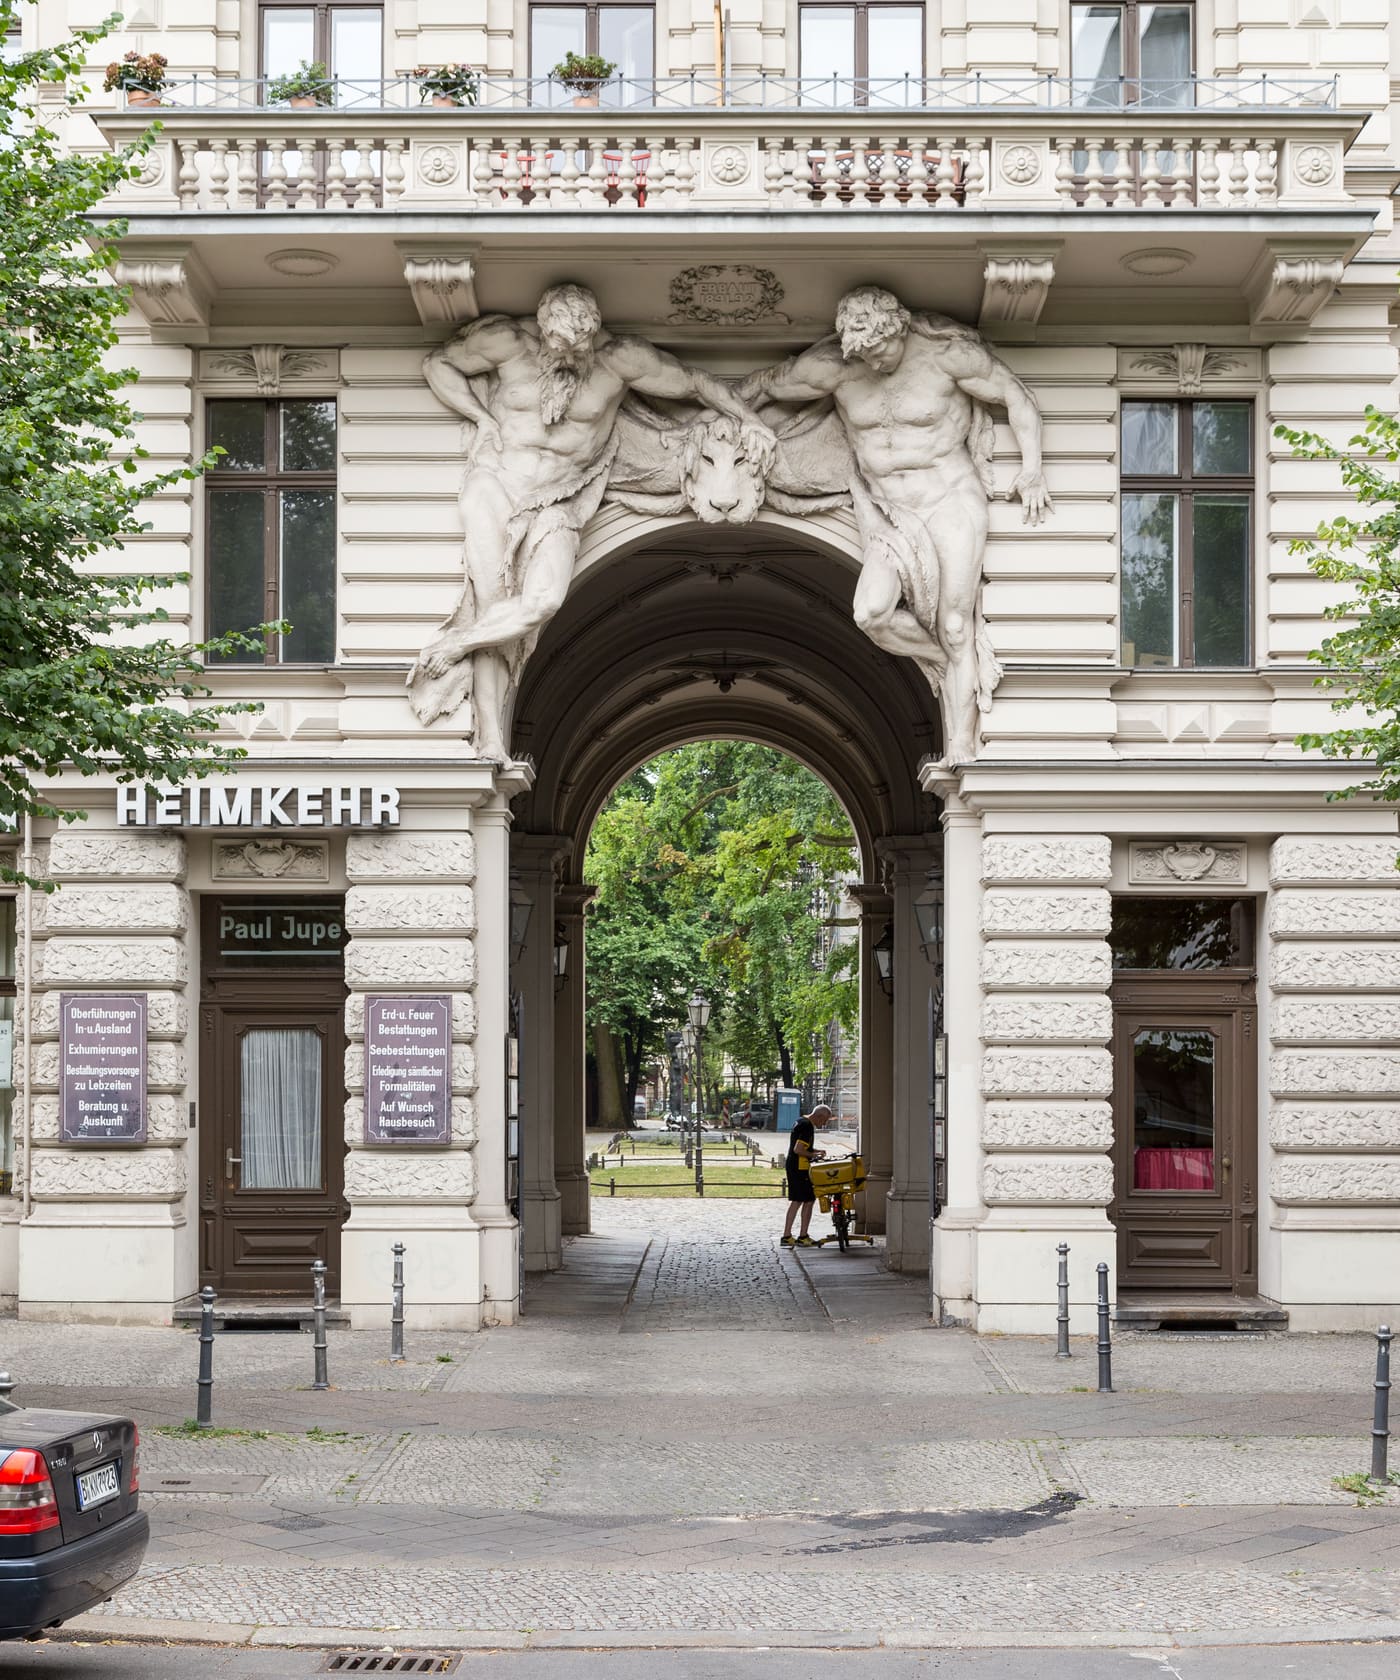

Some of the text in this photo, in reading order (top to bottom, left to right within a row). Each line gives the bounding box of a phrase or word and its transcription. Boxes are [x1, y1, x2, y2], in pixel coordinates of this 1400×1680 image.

[116, 786, 402, 826] HEIMKEHR
[220, 916, 342, 945] Paul Jupe
[71, 1007, 137, 1021] Überführungen
[408, 1008, 435, 1021] Feuer
[378, 1024, 438, 1038] Bestattungen
[68, 1043, 138, 1057] Exhumierungen
[370, 1044, 446, 1059] Seebestattungen
[66, 1064, 140, 1078] Bestattungsvorsorge
[372, 1065, 443, 1079] Erledigung sämtlicher
[74, 1079, 132, 1091] zu Lebzeiten
[379, 1080, 436, 1092] Formalitäten
[78, 1100, 129, 1114] Beratung u.
[380, 1100, 434, 1112] Auf Wunsch
[83, 1115, 124, 1127] Auskunft
[379, 1116, 435, 1128] Hausbesuch
